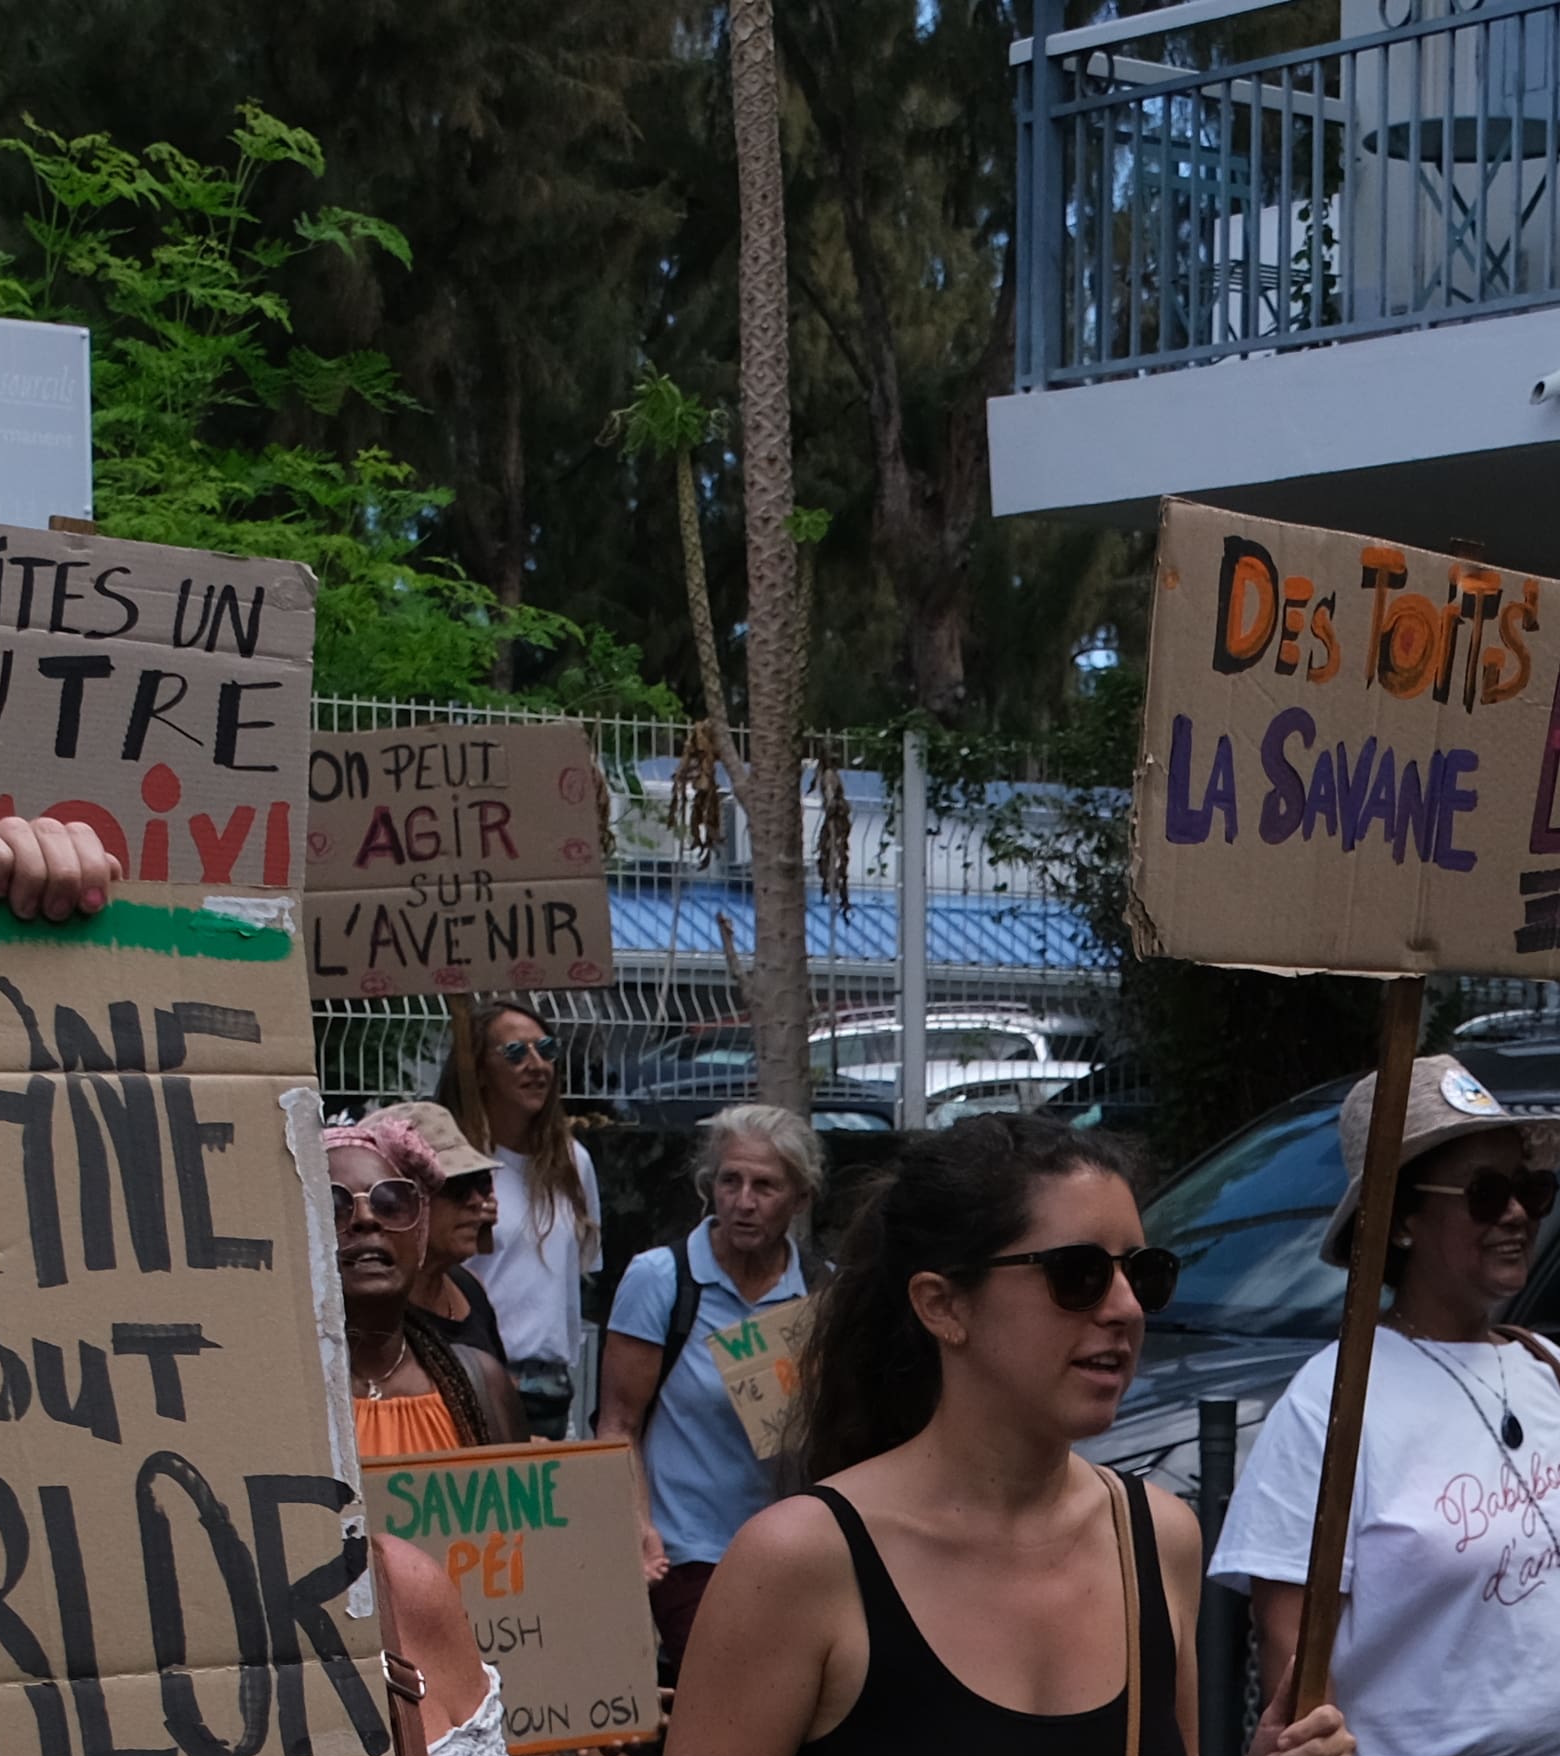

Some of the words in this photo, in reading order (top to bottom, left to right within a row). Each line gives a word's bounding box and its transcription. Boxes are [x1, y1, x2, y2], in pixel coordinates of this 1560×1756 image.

[171, 577, 267, 660] UN
[1211, 533, 1342, 686] DES
[381, 740, 502, 793] PEUT
[1165, 712, 1238, 846] LA
[1258, 707, 1480, 873] SAVANE
[406, 869, 495, 908] SUR
[385, 1460, 569, 1541] SAVANE
[466, 1612, 544, 1654] USH
